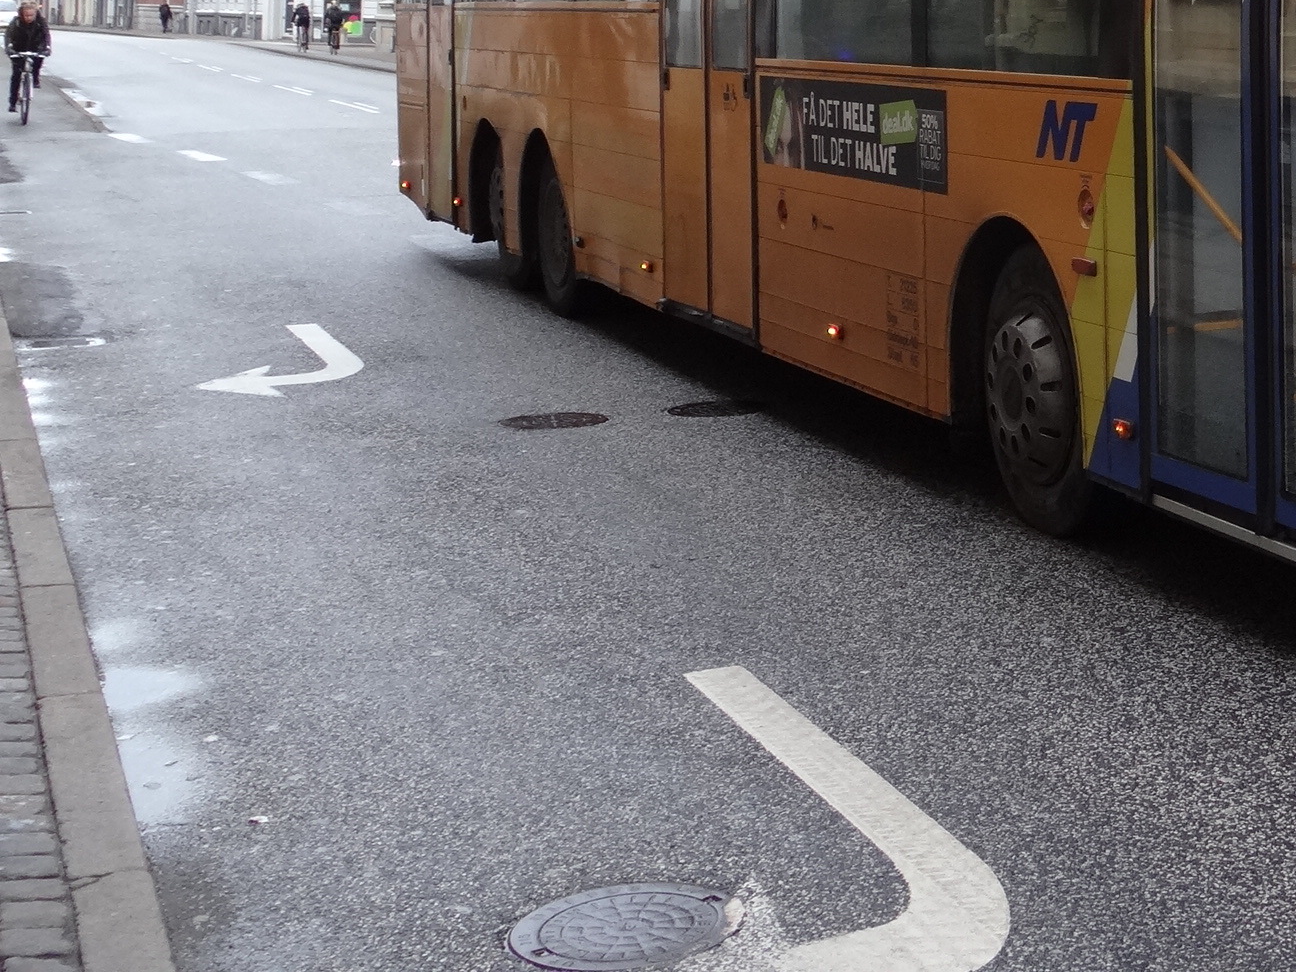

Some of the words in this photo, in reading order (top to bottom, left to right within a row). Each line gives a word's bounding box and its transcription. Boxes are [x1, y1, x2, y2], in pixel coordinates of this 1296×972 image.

[803, 91, 817, 127] FÅ
[819, 98, 840, 129] DET
[843, 101, 875, 133] HELE
[921, 114, 938, 130] 50%
[1036, 99, 1098, 162] NT
[811, 134, 828, 165] TIL
[830, 137, 852, 167] DET
[855, 140, 897, 176] HALVE
[919, 128, 941, 145] RABAT
